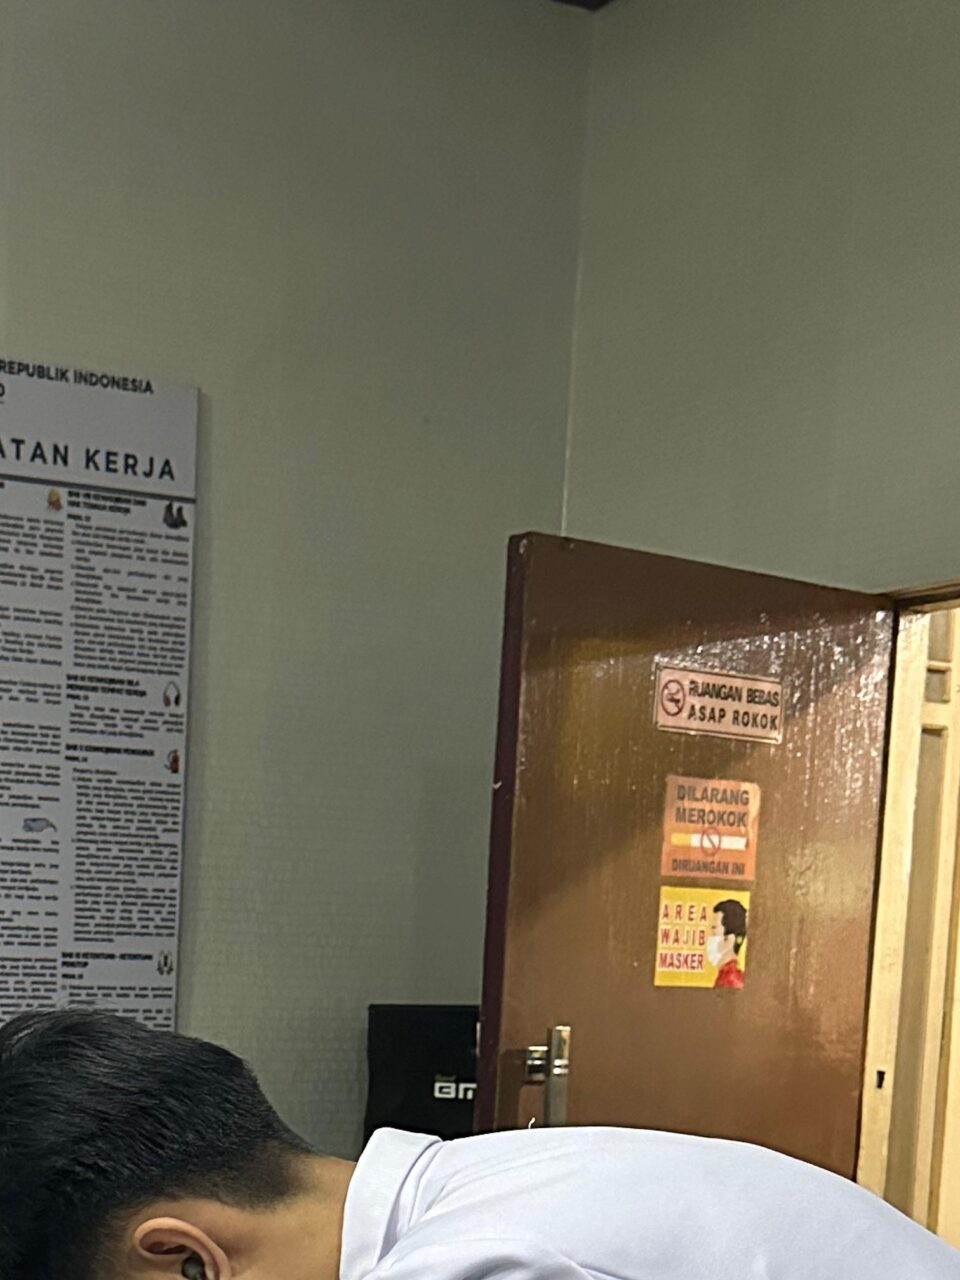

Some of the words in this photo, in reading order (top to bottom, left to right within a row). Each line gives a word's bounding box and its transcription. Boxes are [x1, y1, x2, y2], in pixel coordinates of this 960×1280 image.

[73, 369, 155, 395] INDONESIA
[84, 447, 176, 481] KERJA
[688, 680, 743, 703] RUANGAN
[746, 687, 780, 707] BEBAS
[687, 704, 727, 724] ASAP
[732, 710, 778, 730] ROKOK
[676, 784, 750, 806] DILARANG
[674, 806, 748, 828] MEROKOK
[671, 859, 729, 874] DIRUANGAN
[731, 862, 746, 875] INI
[661, 903, 707, 922] AREA
[660, 927, 706, 947] WAJIB
[658, 952, 704, 970] MASKER
